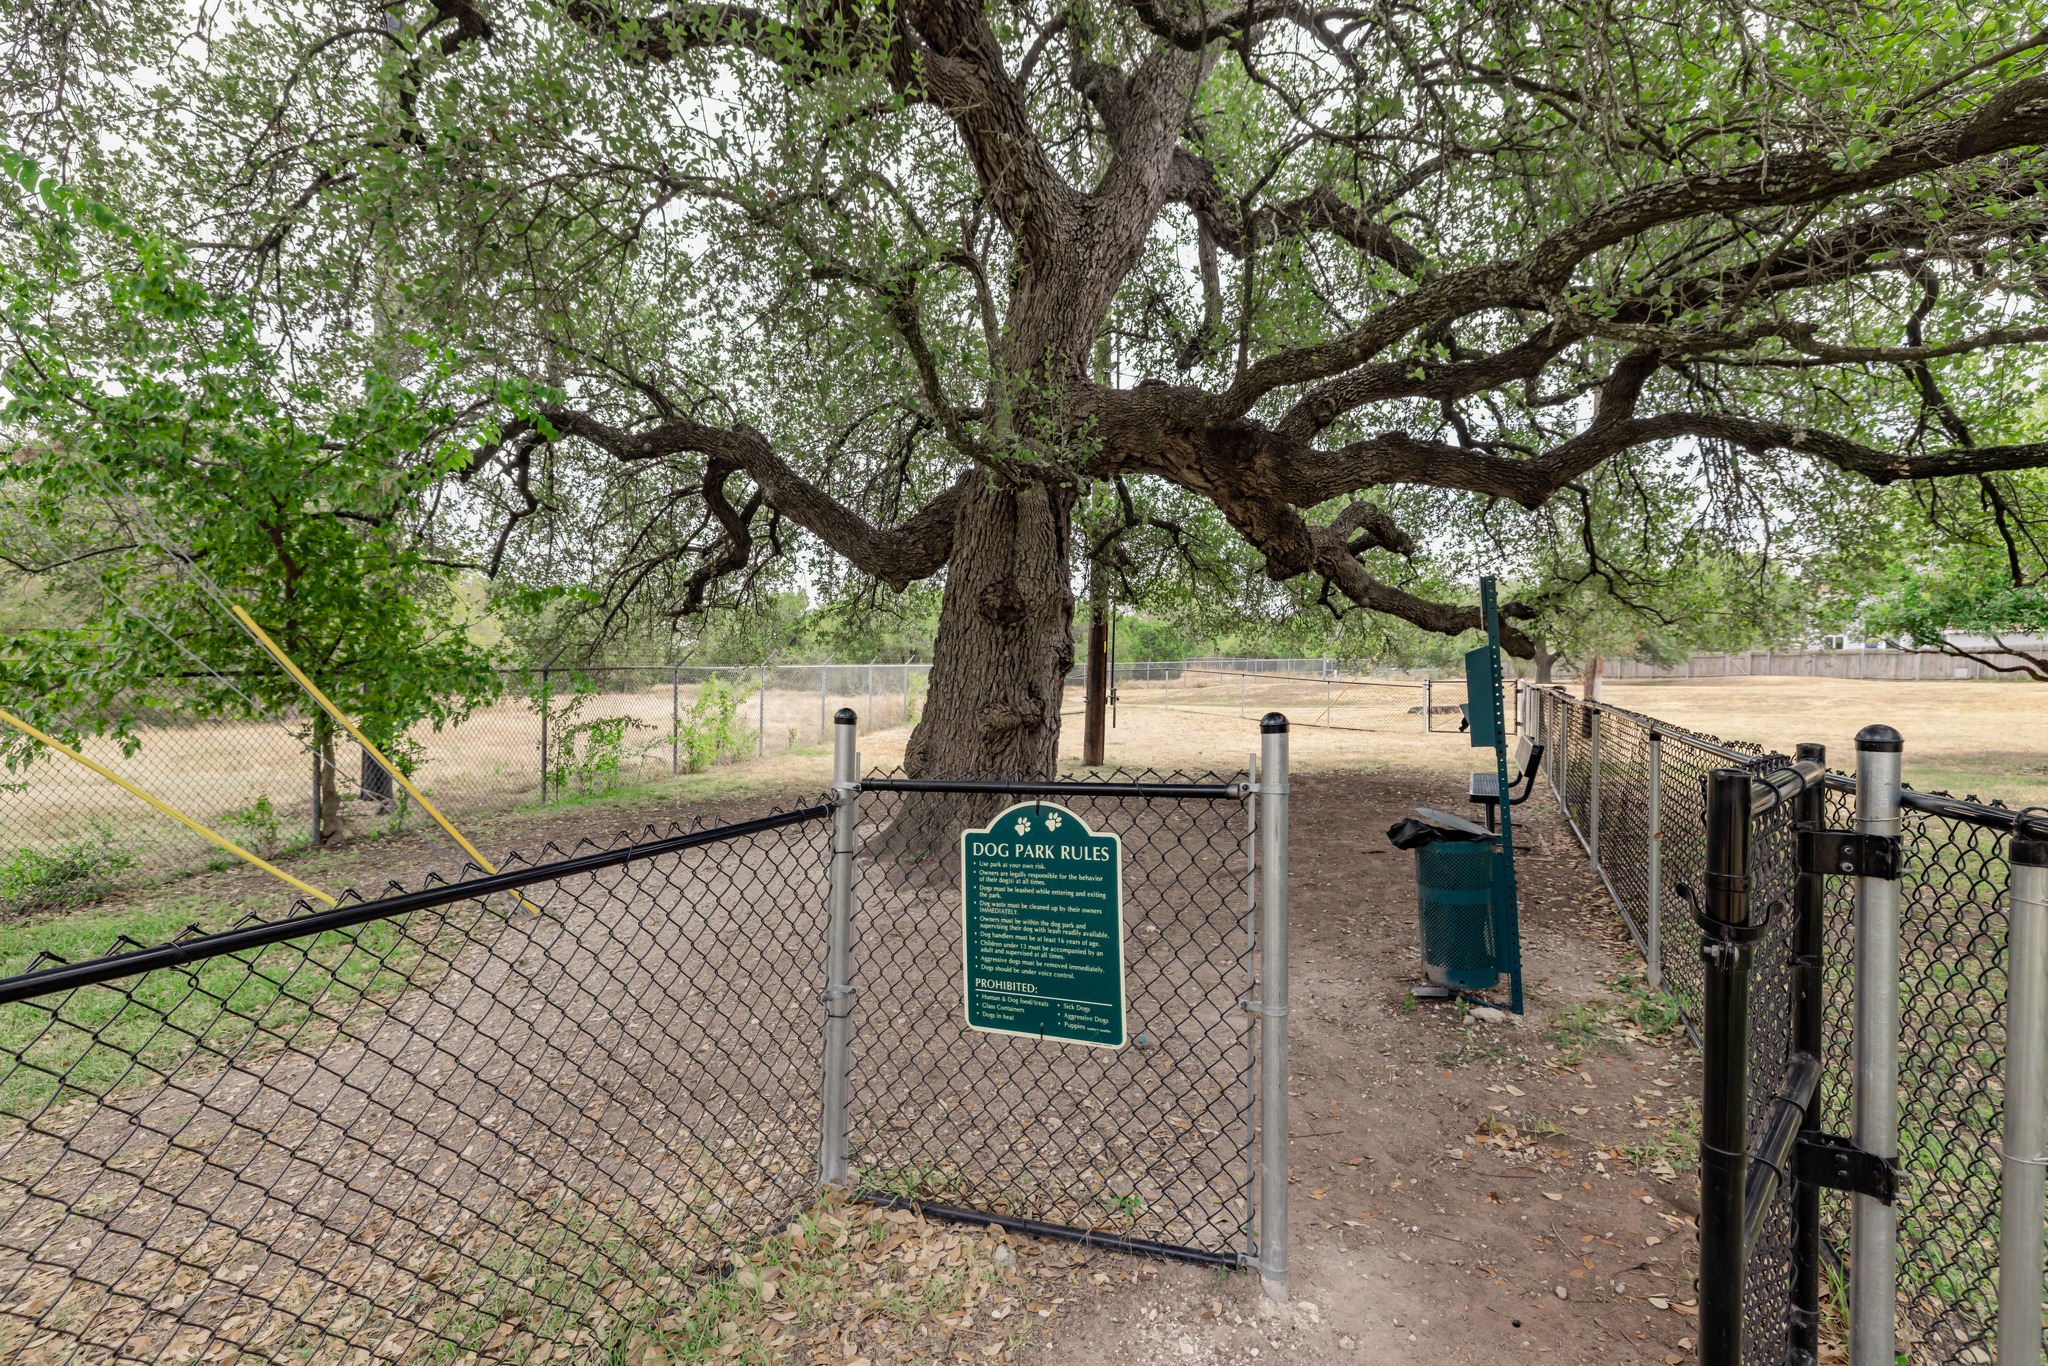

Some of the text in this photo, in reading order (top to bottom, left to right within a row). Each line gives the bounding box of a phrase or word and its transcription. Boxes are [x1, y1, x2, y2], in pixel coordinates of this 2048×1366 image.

[973, 842, 1109, 861] DOG PARK RULES
[1052, 890, 1074, 898] entering
[1087, 891, 1106, 900] exiting
[1069, 963, 1105, 974] immediately.
[975, 978, 1038, 994] PROHIBITED:
[997, 1004, 1025, 1013] Containers
[1076, 1005, 1091, 1013] Dogs
[982, 1011, 995, 1019] Dogs
[1064, 1013, 1109, 1025] Aggressive Dogs
[1064, 1022, 1085, 1030] Puppies
